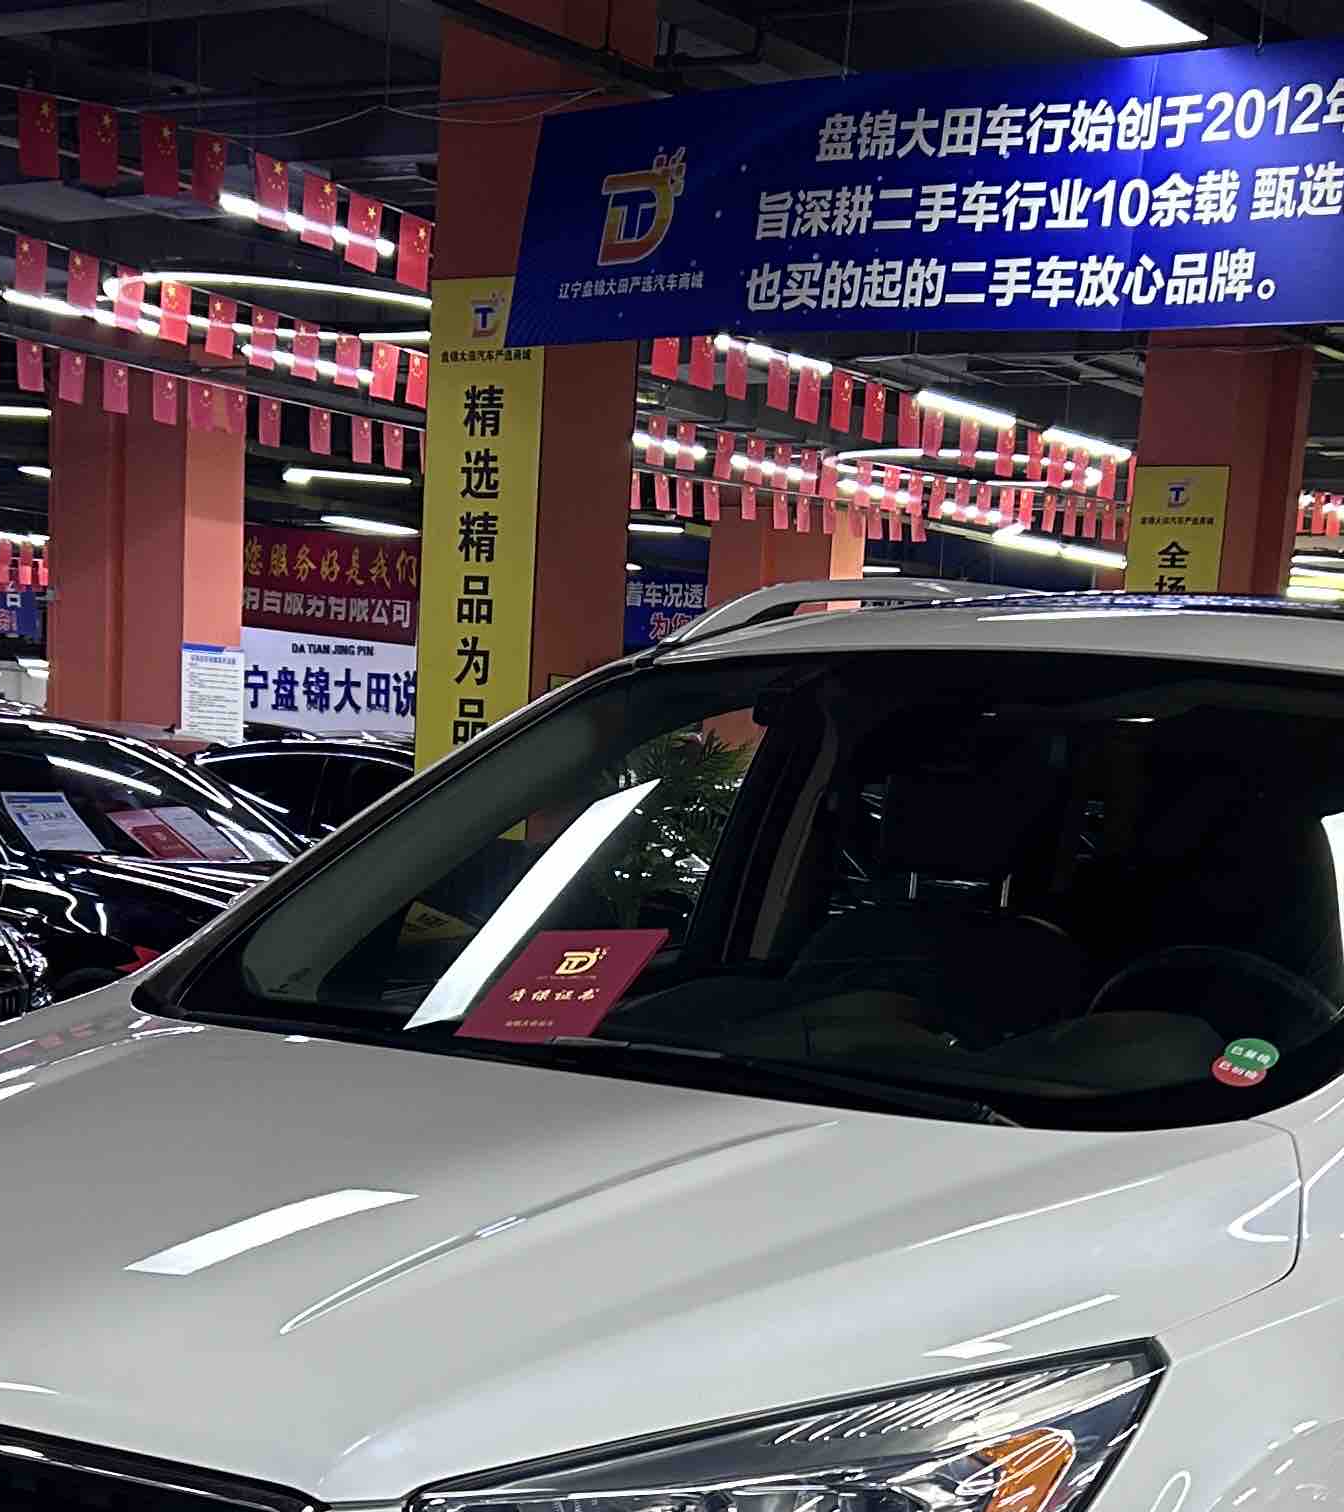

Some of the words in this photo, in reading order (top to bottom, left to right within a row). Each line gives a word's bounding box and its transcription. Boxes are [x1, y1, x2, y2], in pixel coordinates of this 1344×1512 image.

[756, 167, 1239, 241] 旨深耕二手车行业10余载
[746, 247, 1278, 311] 也买的起的二手车放心品牌。
